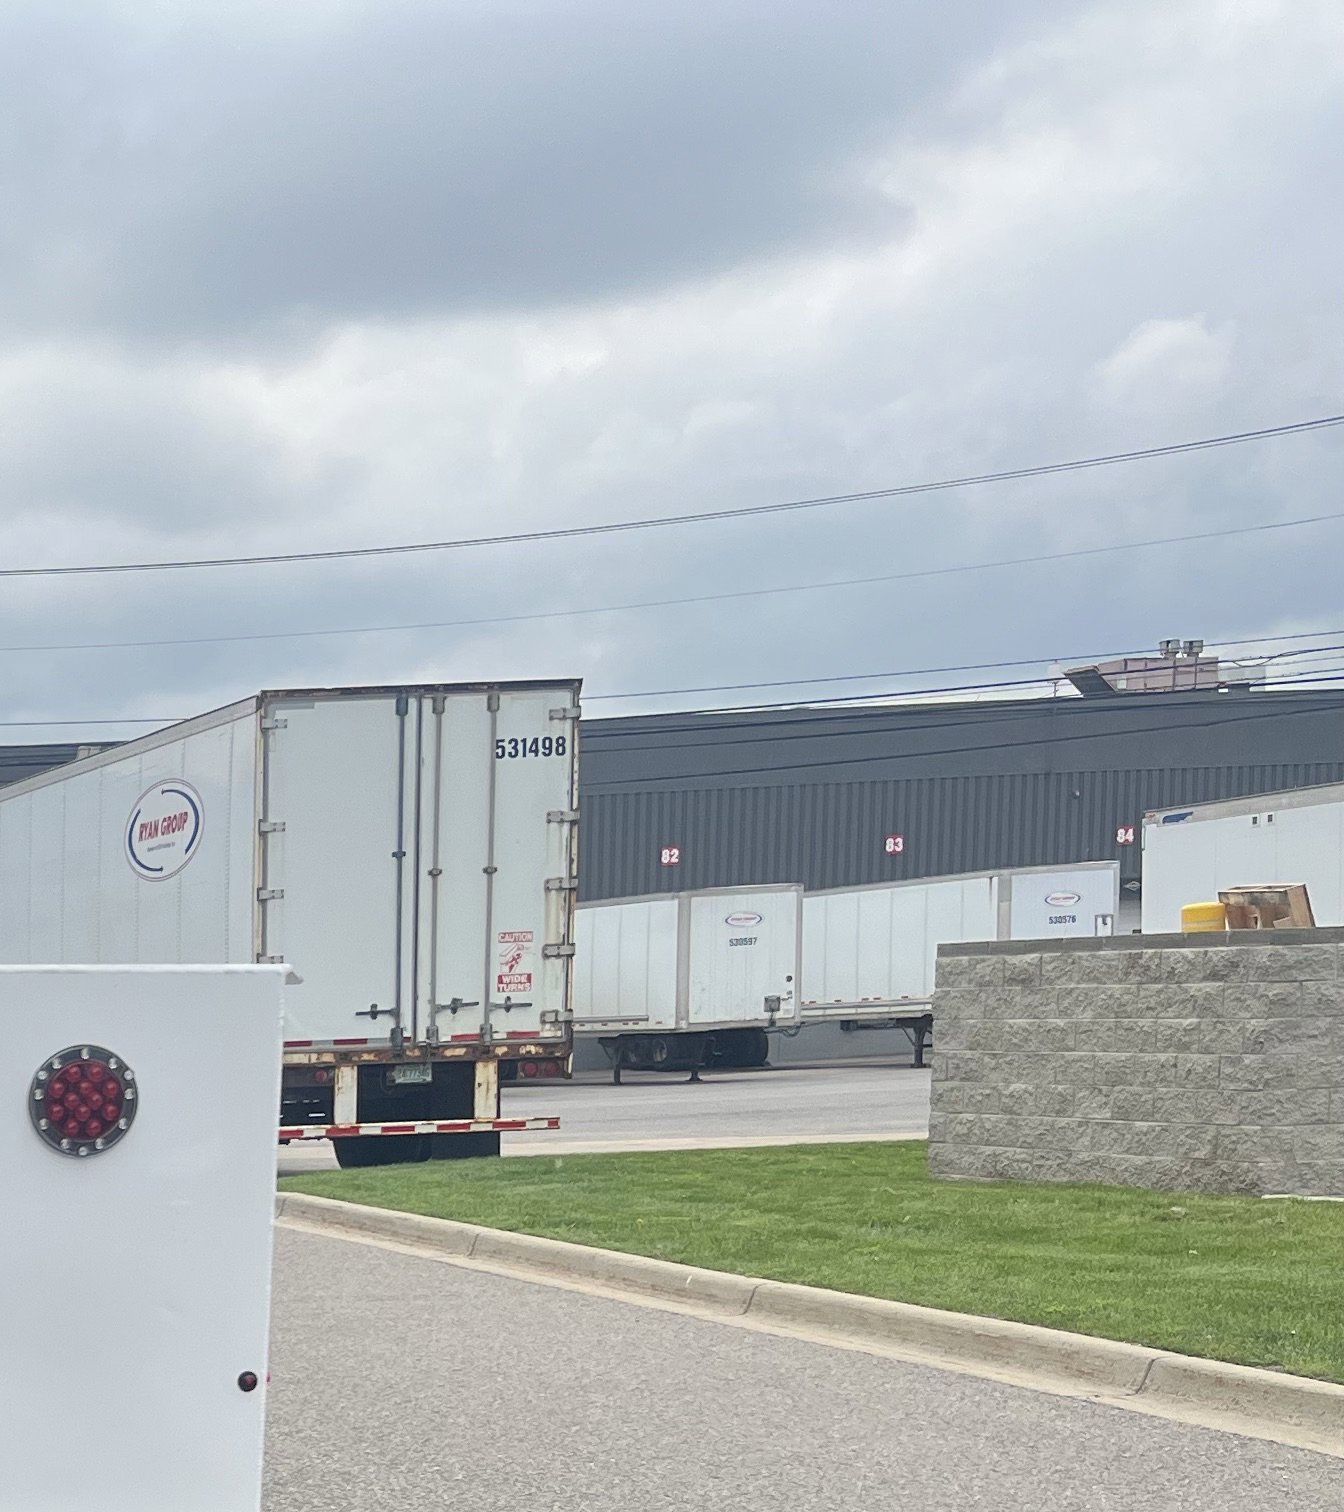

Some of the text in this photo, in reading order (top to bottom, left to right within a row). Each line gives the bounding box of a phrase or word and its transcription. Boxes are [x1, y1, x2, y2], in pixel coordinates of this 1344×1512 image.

[496, 736, 566, 760] 531498
[138, 811, 188, 842] RYAN GROUP
[1117, 828, 1134, 842] 84
[886, 837, 903, 852] 83
[661, 848, 679, 863] 82
[500, 932, 532, 942] CAUTION
[502, 974, 528, 984] WIDE
[498, 982, 531, 992] TURNS
